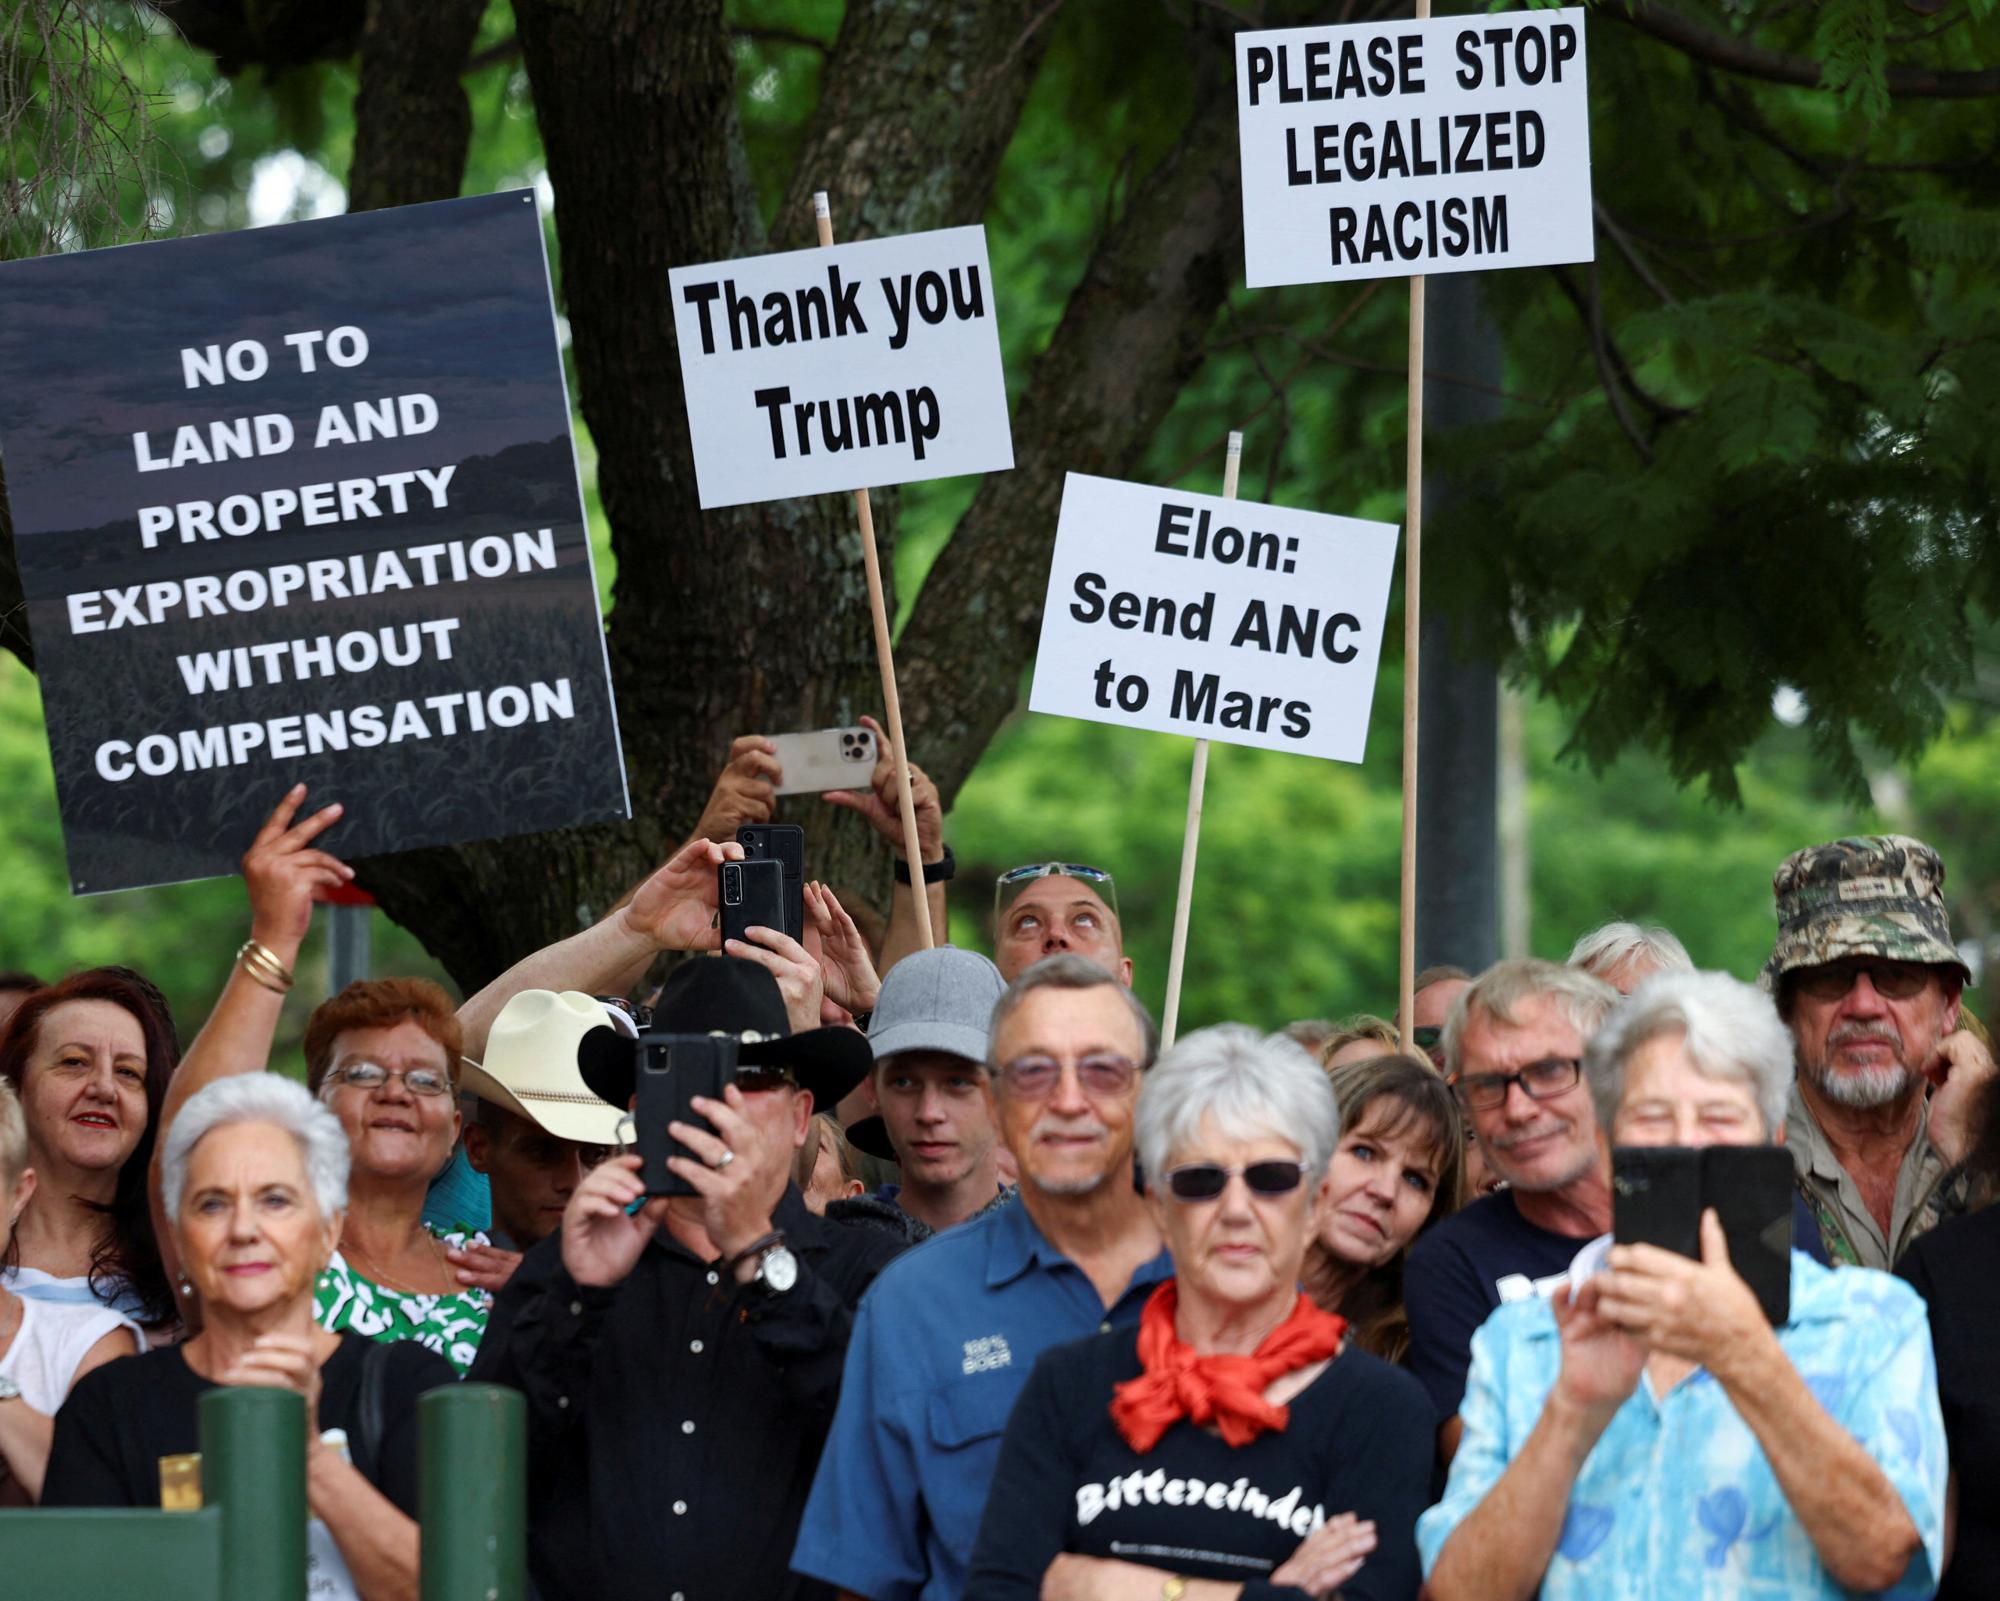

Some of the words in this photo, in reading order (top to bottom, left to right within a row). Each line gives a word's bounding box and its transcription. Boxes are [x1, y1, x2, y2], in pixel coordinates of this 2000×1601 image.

[1248, 35, 1425, 105] PLEASE
[1456, 24, 1576, 90] STOP
[1286, 110, 1544, 186] LEGALIZED
[1330, 195, 1508, 265] RACISM
[683, 265, 868, 354] Thank
[880, 265, 984, 349] you
[181, 340, 268, 388] NO
[285, 326, 368, 372] TO
[134, 414, 294, 472] LAND
[315, 394, 438, 447] AND
[755, 386, 940, 460] Trump
[138, 466, 456, 548] PROPERTY
[1155, 504, 1298, 573] Elon:
[67, 529, 556, 634] EXPROPRIATION
[1070, 573, 1215, 641] Send
[1231, 600, 1360, 663] ANC
[177, 618, 459, 694] WITHOUT
[96, 679, 574, 781] COMPENSATION
[1094, 660, 1148, 712] to
[1170, 670, 1311, 738] Mars
[962, 1350, 1011, 1375] BOER
